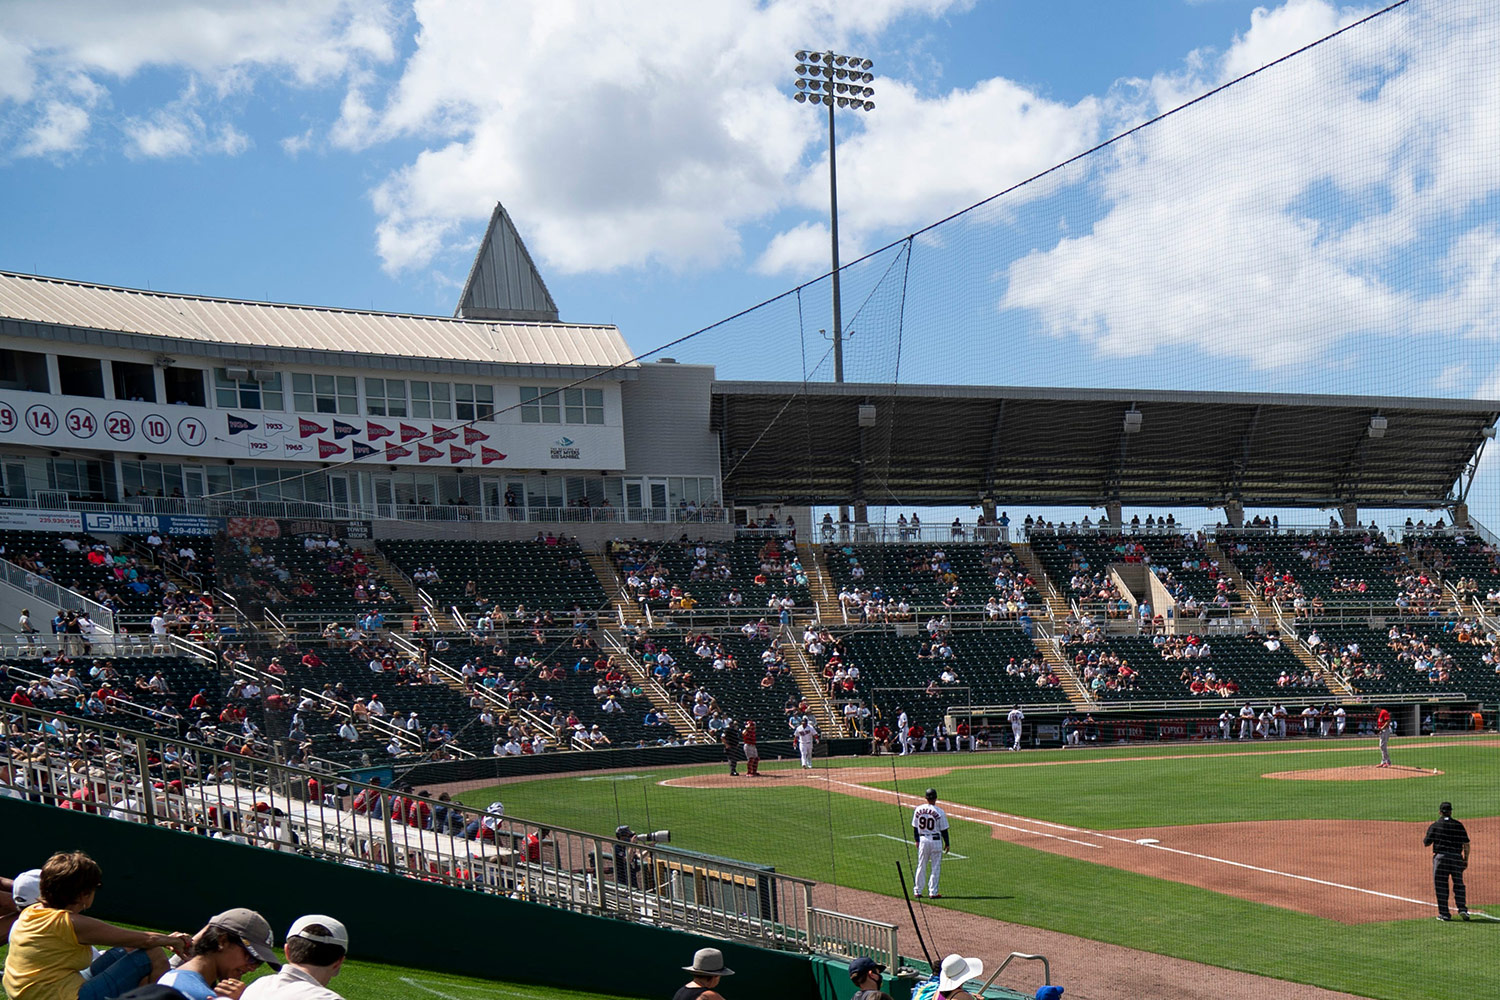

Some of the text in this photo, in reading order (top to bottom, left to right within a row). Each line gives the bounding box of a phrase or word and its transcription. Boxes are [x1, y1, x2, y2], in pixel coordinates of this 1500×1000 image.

[32, 411, 52, 429] 14
[69, 414, 94, 432] 34
[108, 417, 131, 435] 28
[265, 422, 284, 430] 1933
[148, 420, 165, 437] 10
[186, 423, 197, 440] 7
[250, 441, 269, 449] 1925
[285, 443, 304, 451] 1965
[113, 515, 159, 528] JAN-PRO
[1116, 727, 1143, 737] TORO
[1159, 725, 1184, 734] TORO
[918, 816, 935, 831] 90
